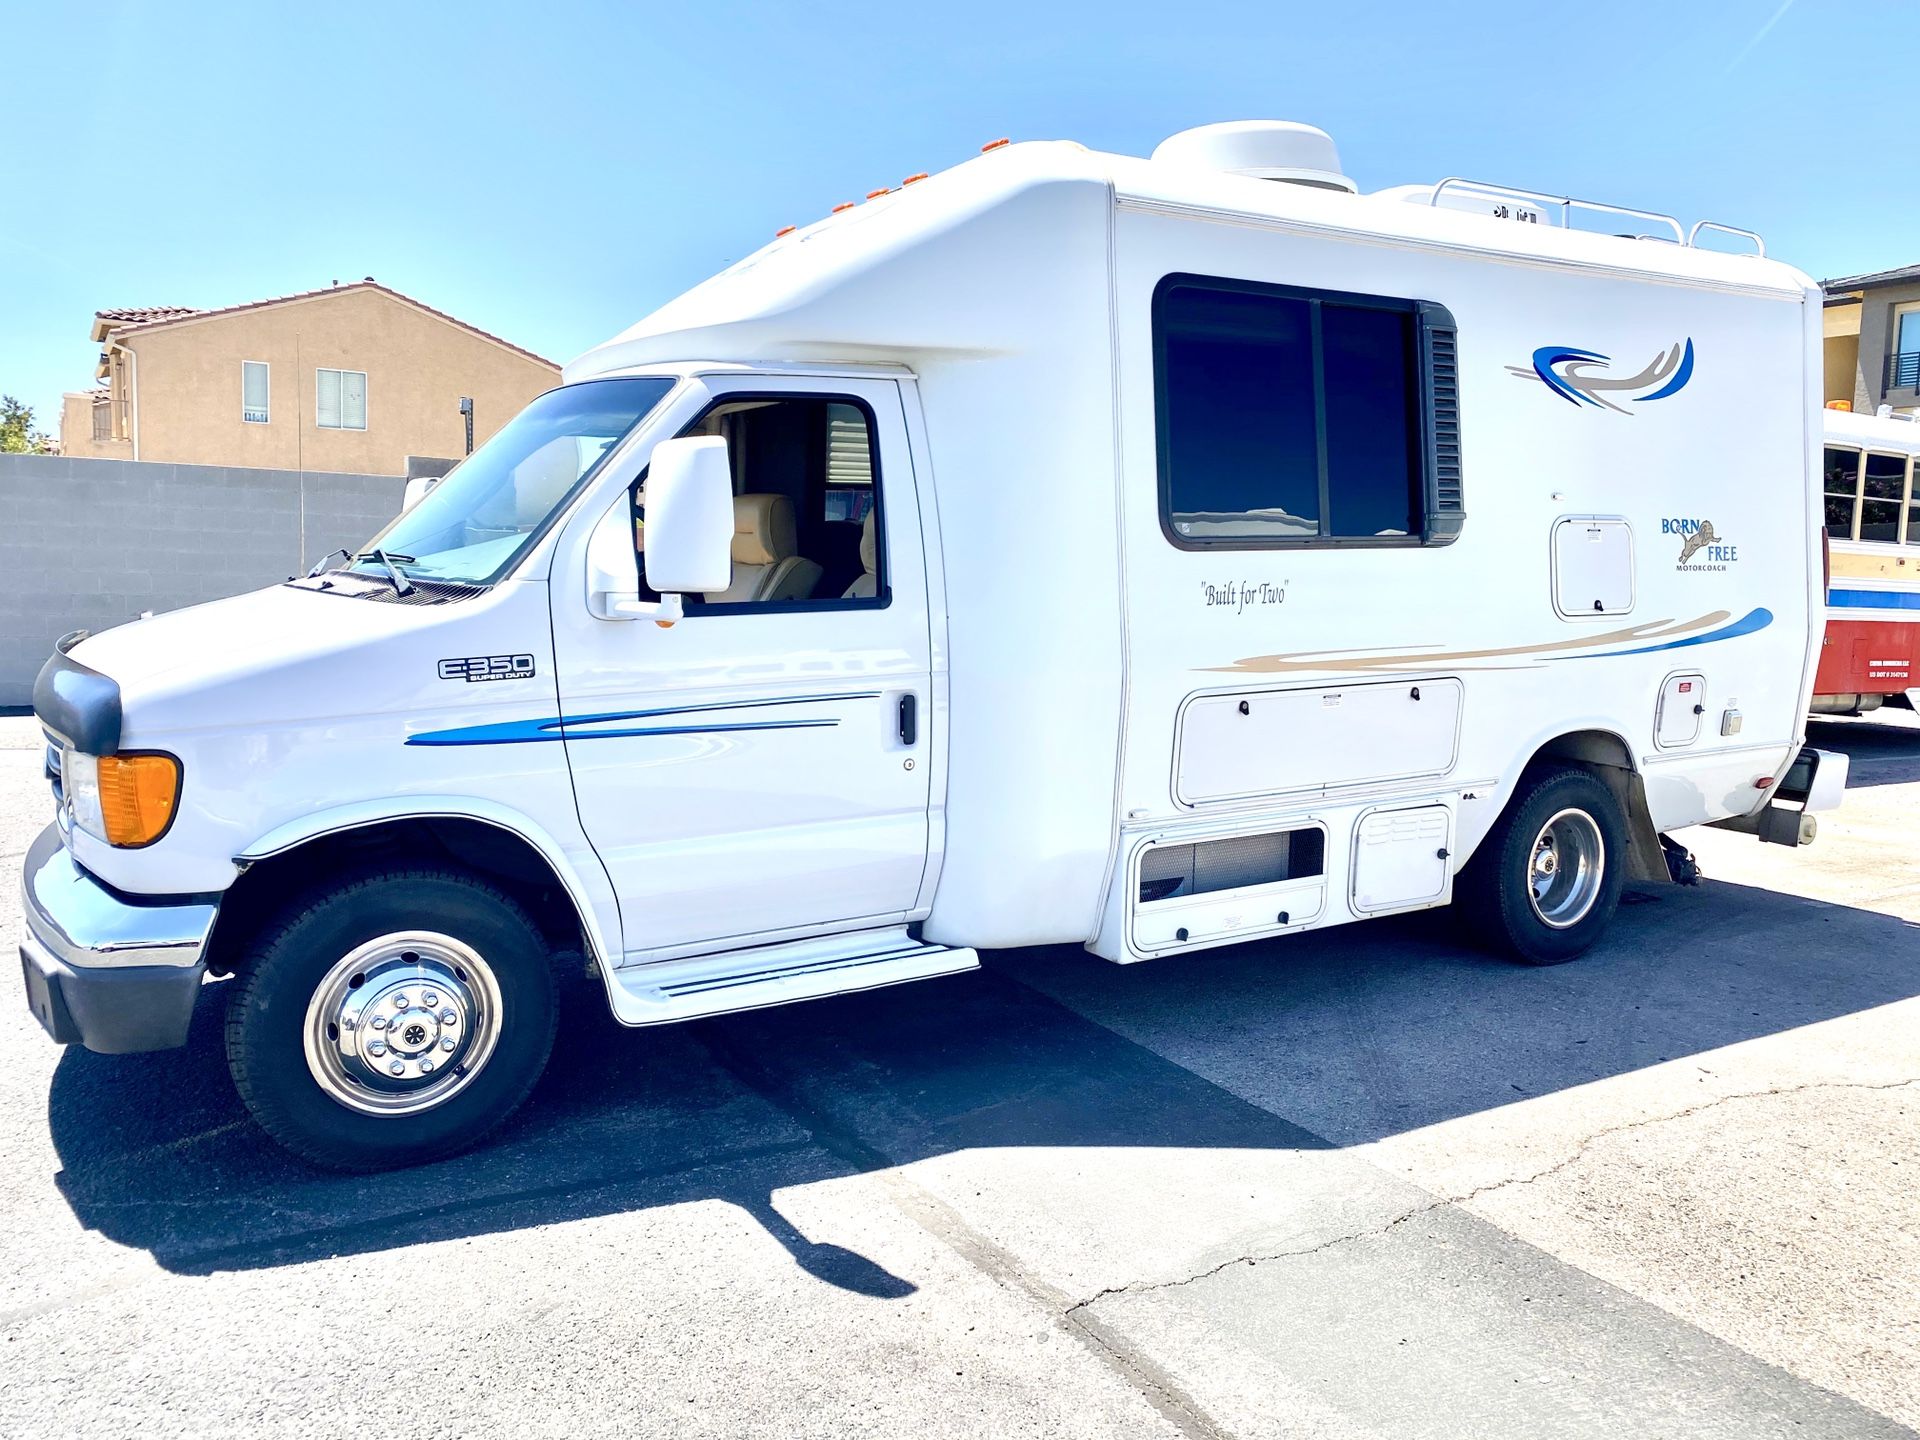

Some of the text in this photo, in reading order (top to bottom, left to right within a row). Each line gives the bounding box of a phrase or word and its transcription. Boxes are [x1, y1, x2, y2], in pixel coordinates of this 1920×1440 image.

[1661, 518, 1700, 534] BORN
[1708, 546, 1738, 561] FREE
[1201, 579, 1289, 615] "Built for Two"
[470, 671, 532, 681] SUPER DUTY
